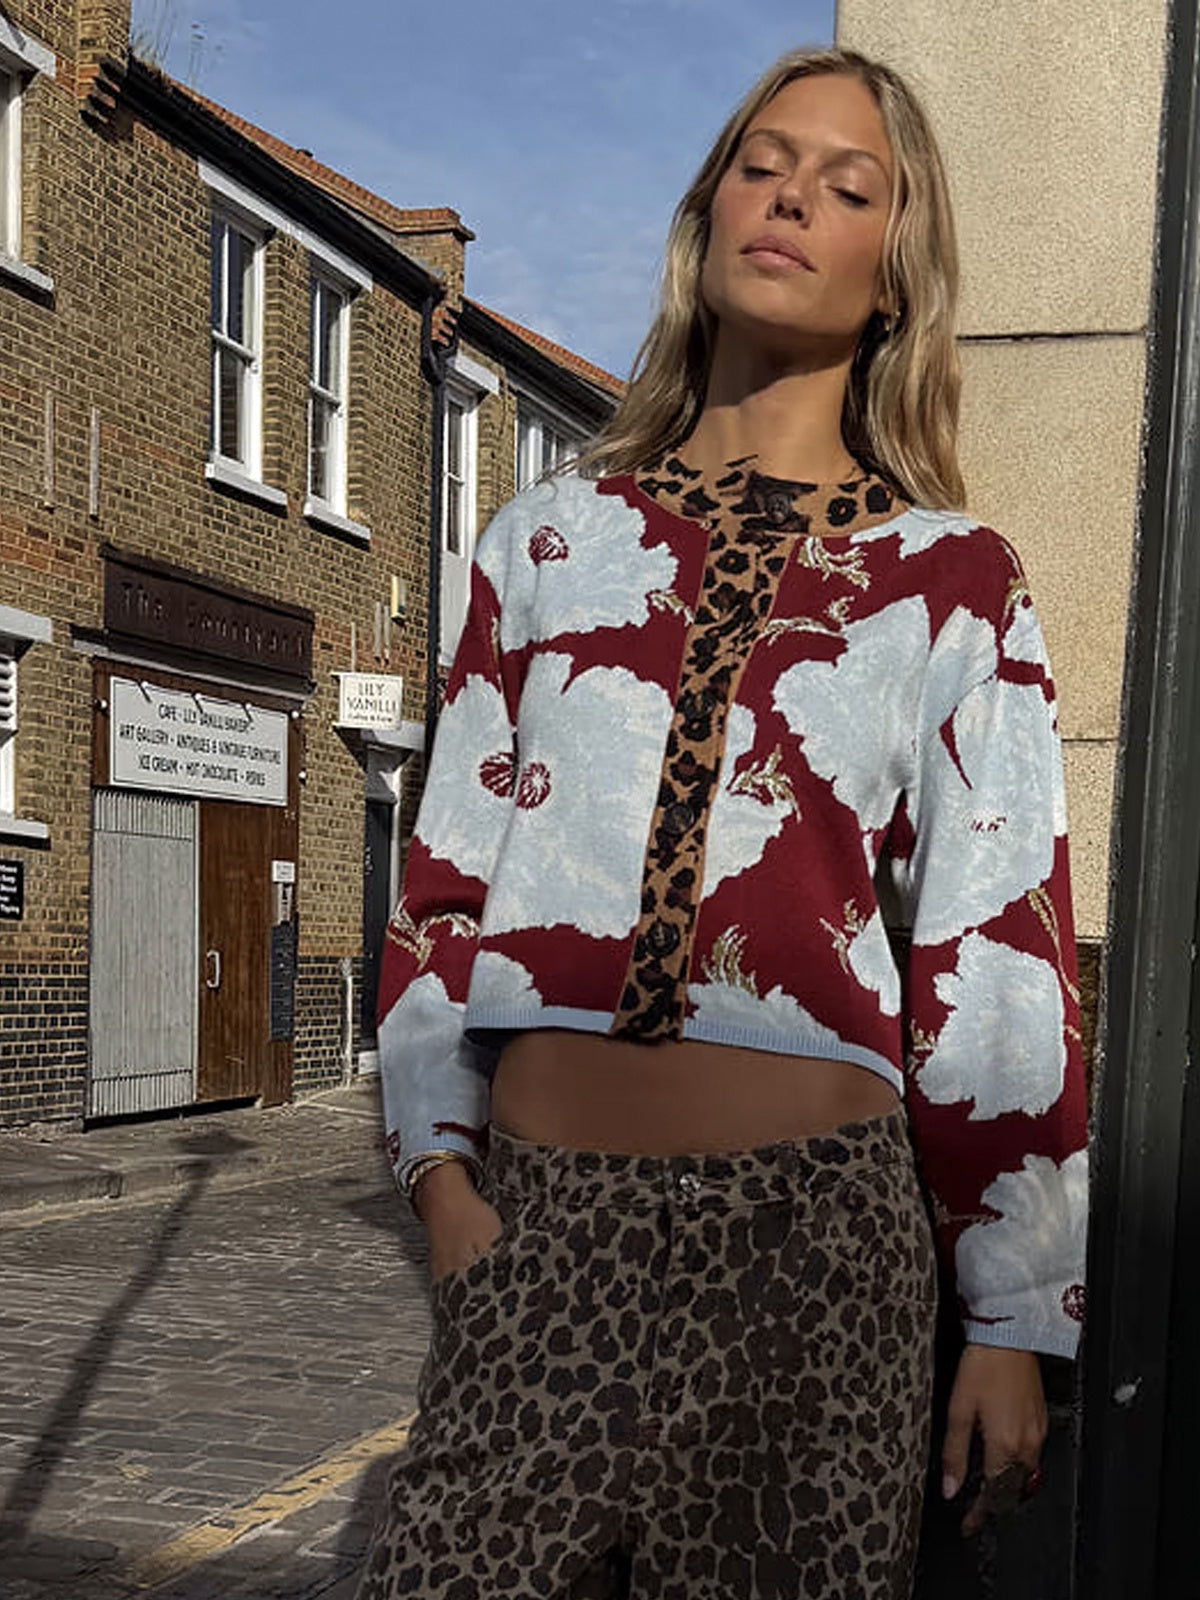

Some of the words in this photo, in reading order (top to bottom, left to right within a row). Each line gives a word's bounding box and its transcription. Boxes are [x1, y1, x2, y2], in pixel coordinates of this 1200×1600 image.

[120, 581, 164, 620] The
[359, 682, 385, 696] LILY
[347, 697, 396, 713] VANILLI
